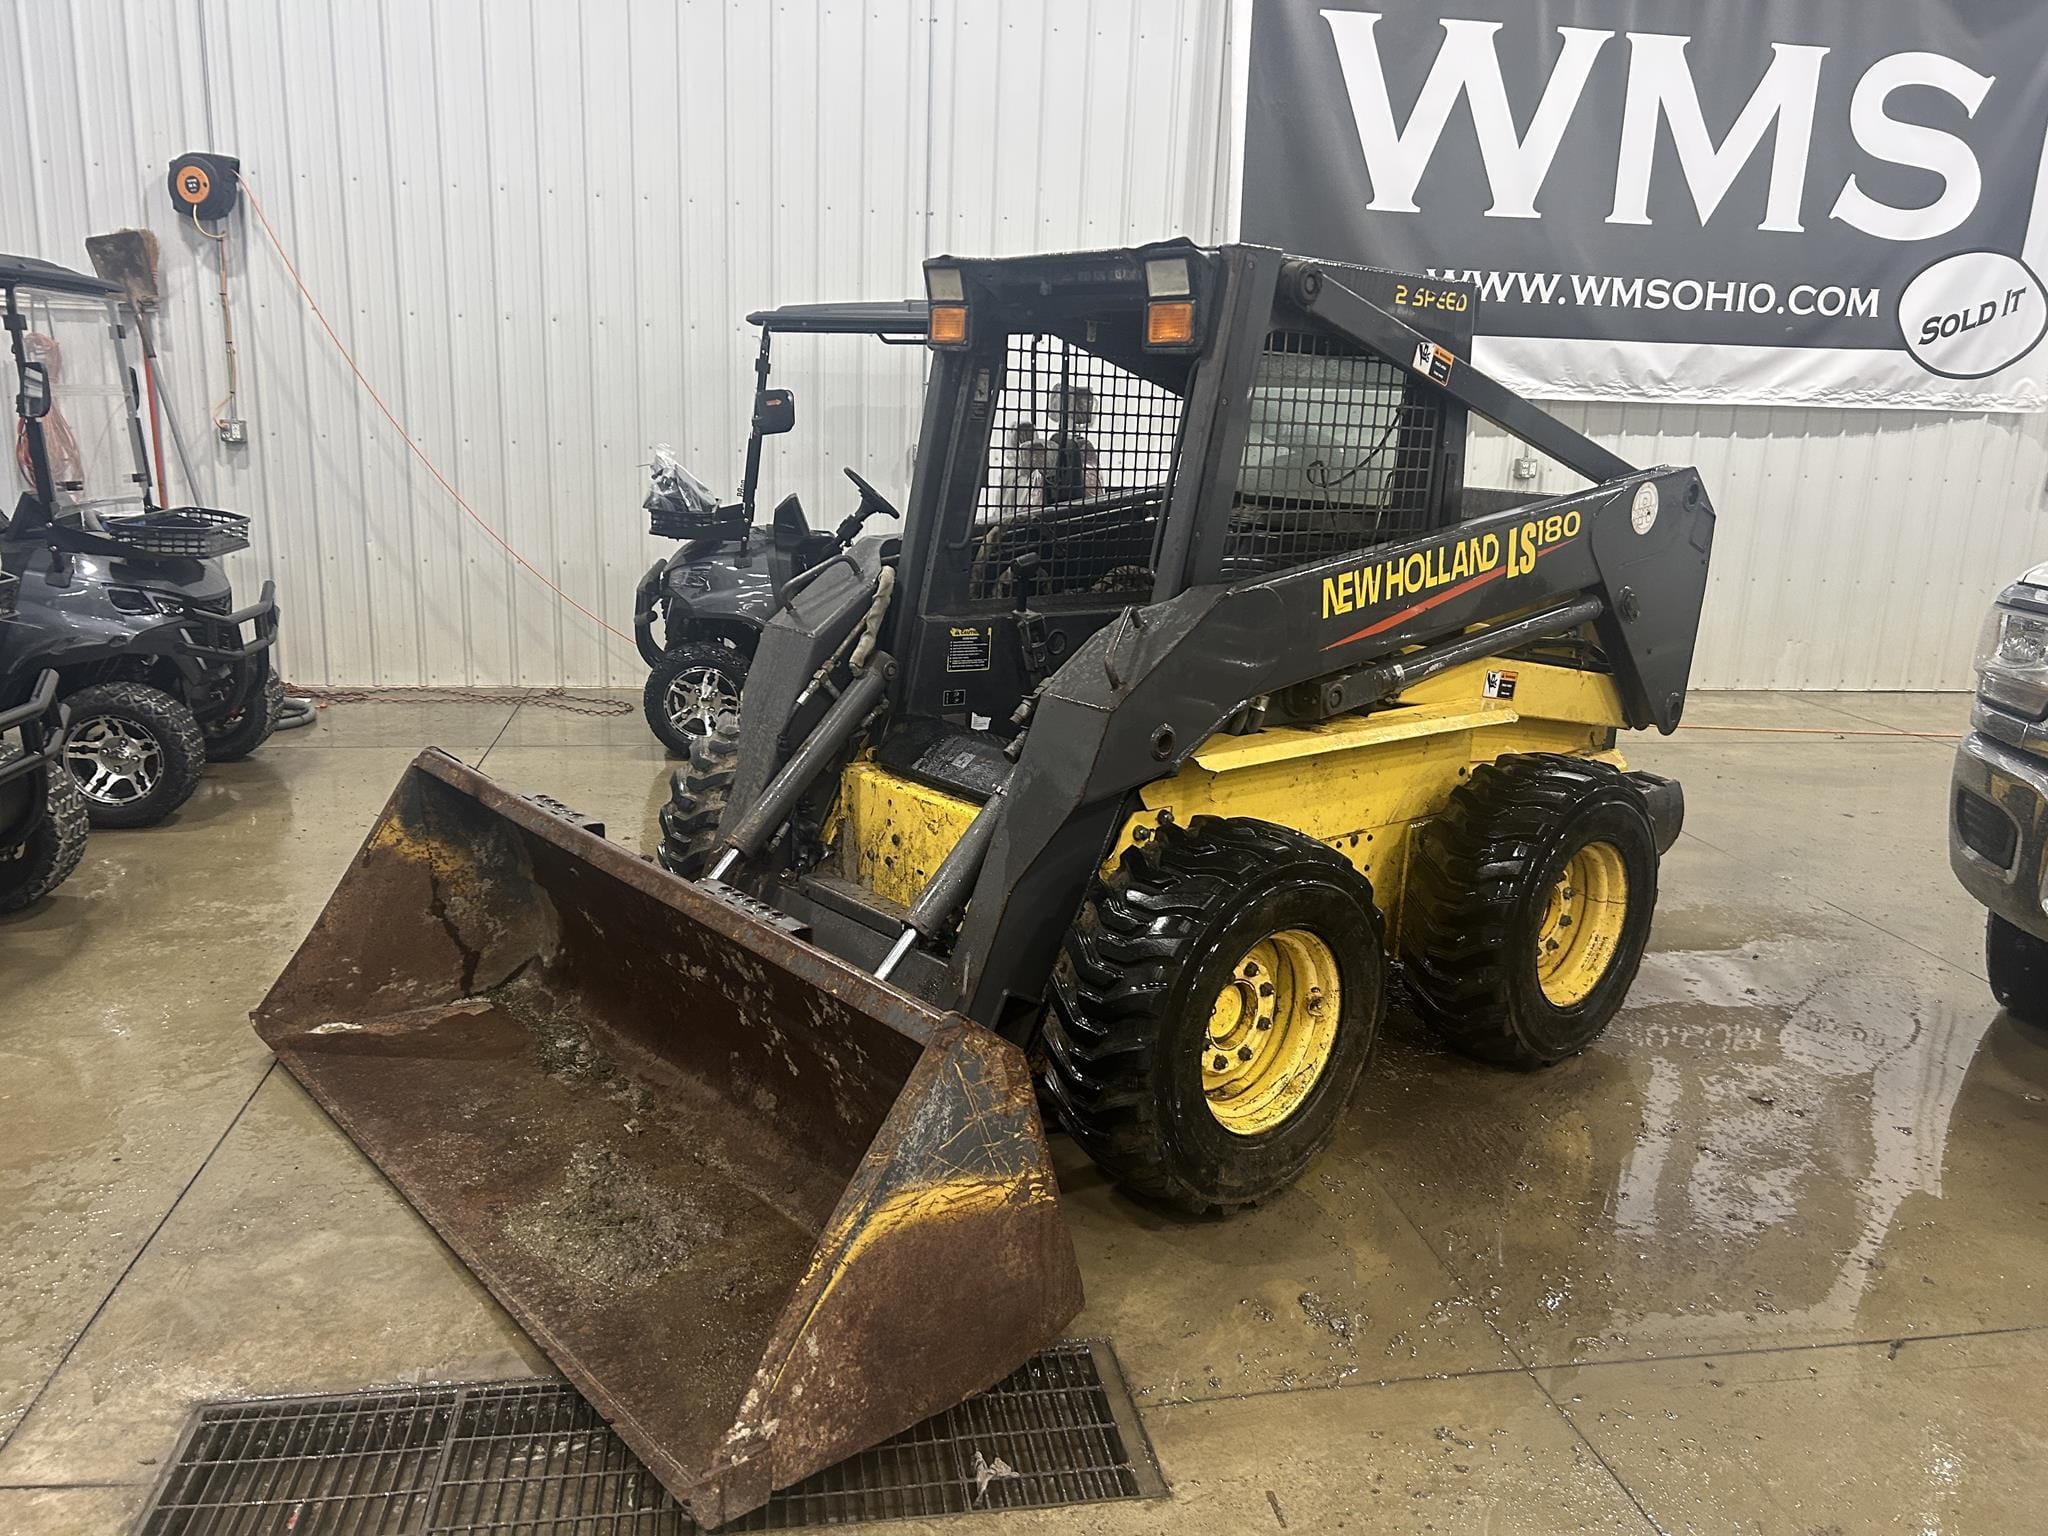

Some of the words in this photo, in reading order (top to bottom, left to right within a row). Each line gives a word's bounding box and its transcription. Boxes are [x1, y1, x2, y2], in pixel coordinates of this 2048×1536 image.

[1319, 9, 1996, 242] WMS
[1394, 284, 1409, 305] 2
[1411, 287, 1468, 312] SPEED
[1918, 300, 1997, 345] SOLD
[2001, 286, 2027, 317] IT
[1322, 564, 1382, 619] NEW
[1386, 533, 1499, 601] HOLLAND
